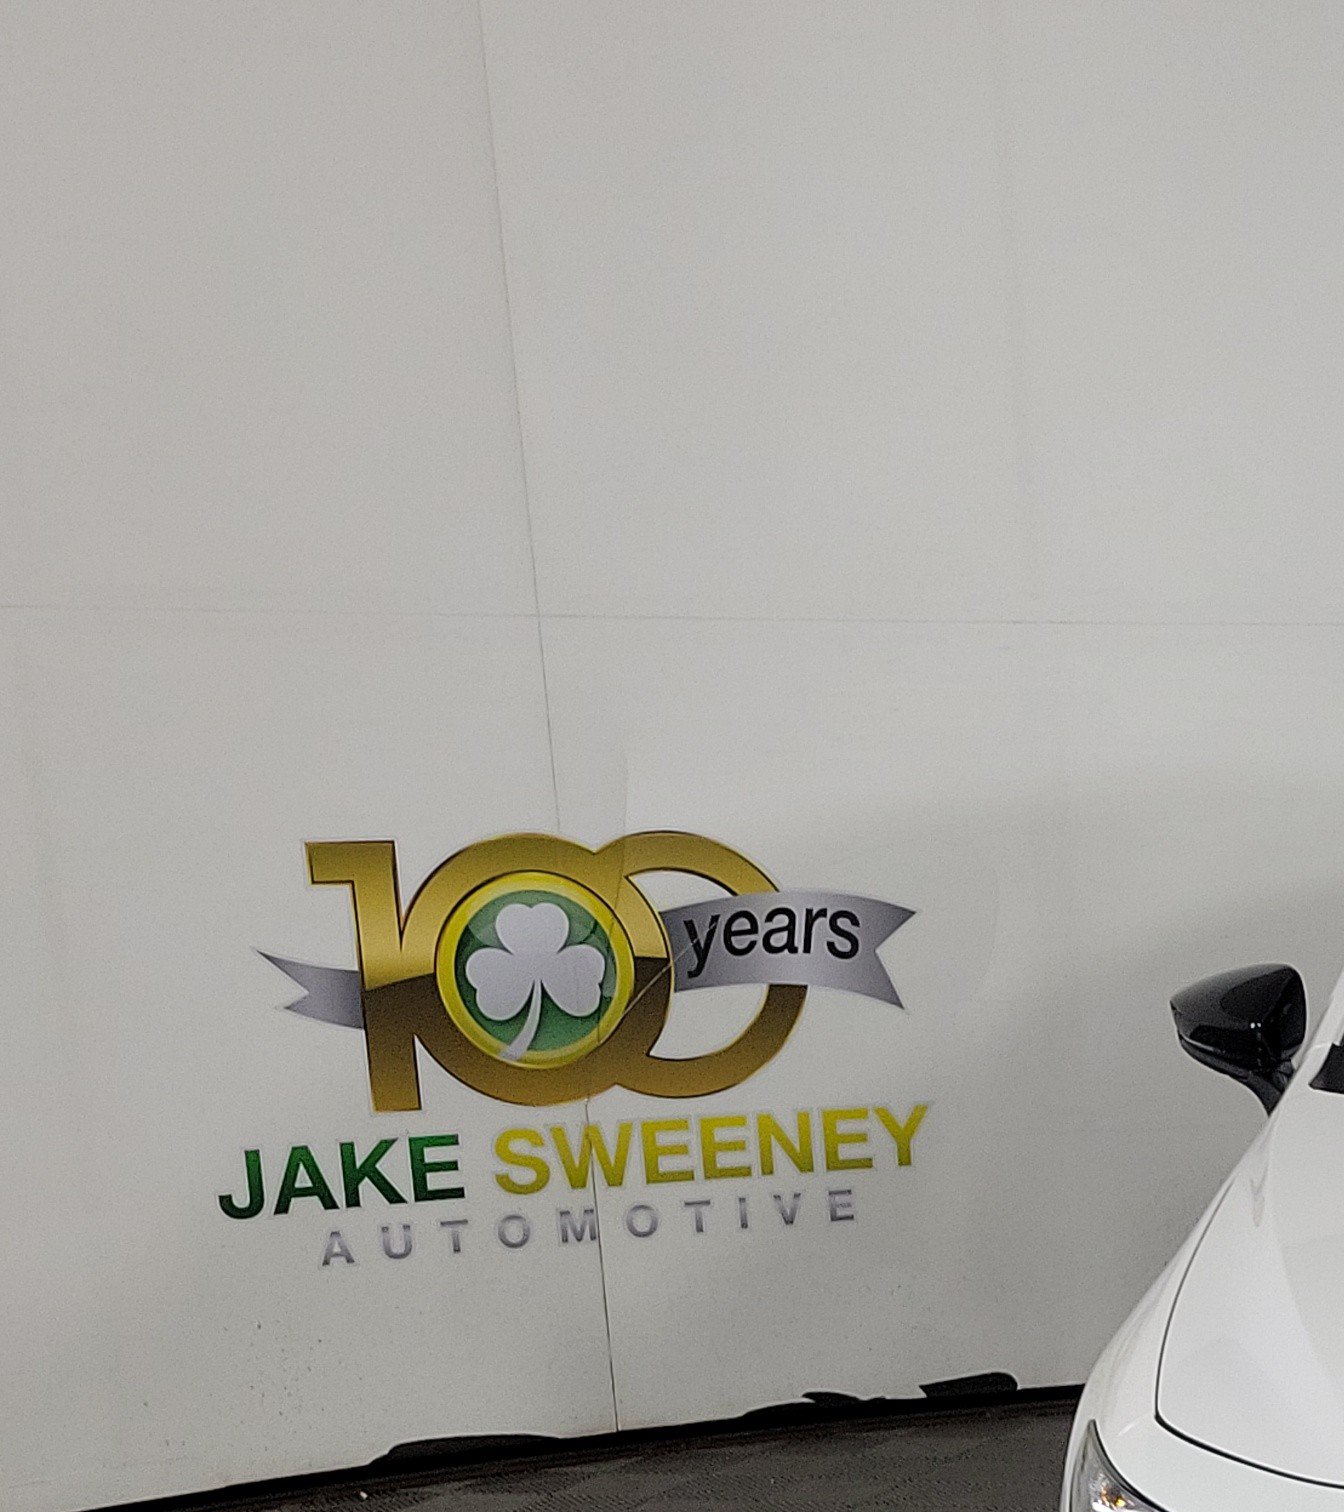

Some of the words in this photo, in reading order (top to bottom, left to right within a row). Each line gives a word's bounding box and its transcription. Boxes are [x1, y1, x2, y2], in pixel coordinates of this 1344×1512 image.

[304, 829, 807, 1112] 100
[683, 905, 861, 978] years
[217, 1133, 466, 1220] JAKE
[493, 1104, 928, 1196] SWEENEY
[321, 1189, 856, 1266] AUTOMOTIVE
